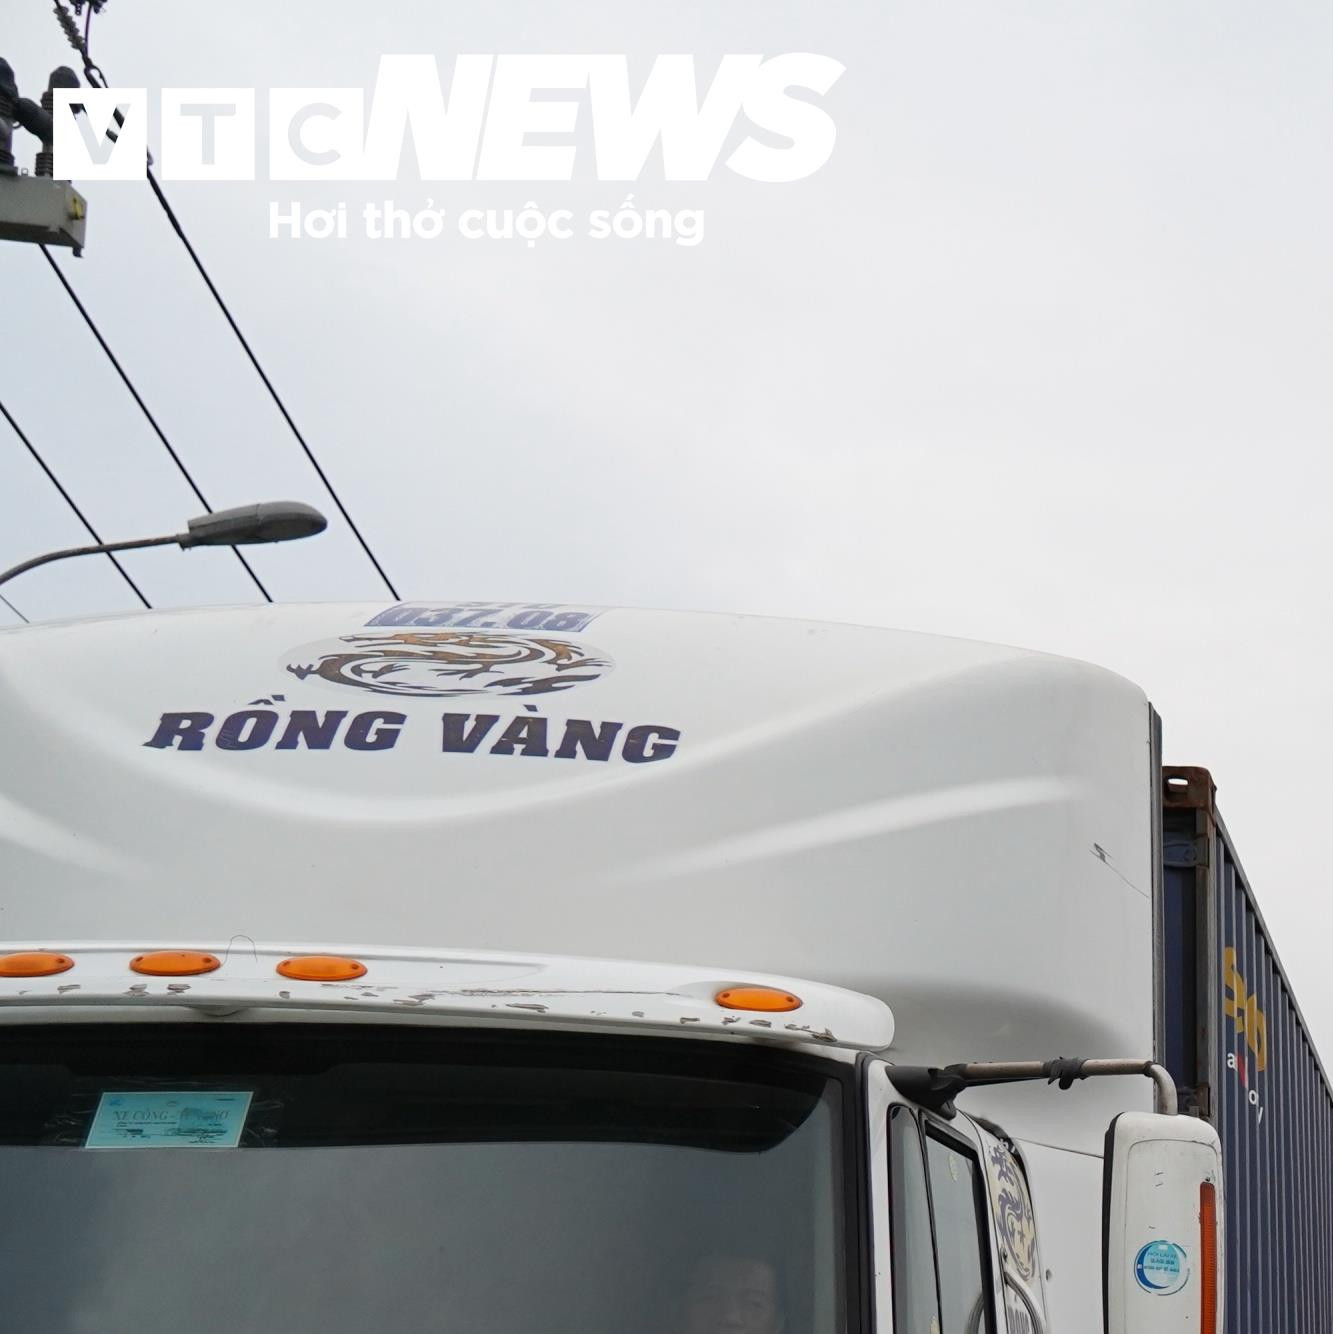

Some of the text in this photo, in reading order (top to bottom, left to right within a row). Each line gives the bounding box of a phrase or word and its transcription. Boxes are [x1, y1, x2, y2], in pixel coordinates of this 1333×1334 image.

[375, 607, 591, 631] 037.08
[141, 694, 683, 764] RỒNG VÀNG
